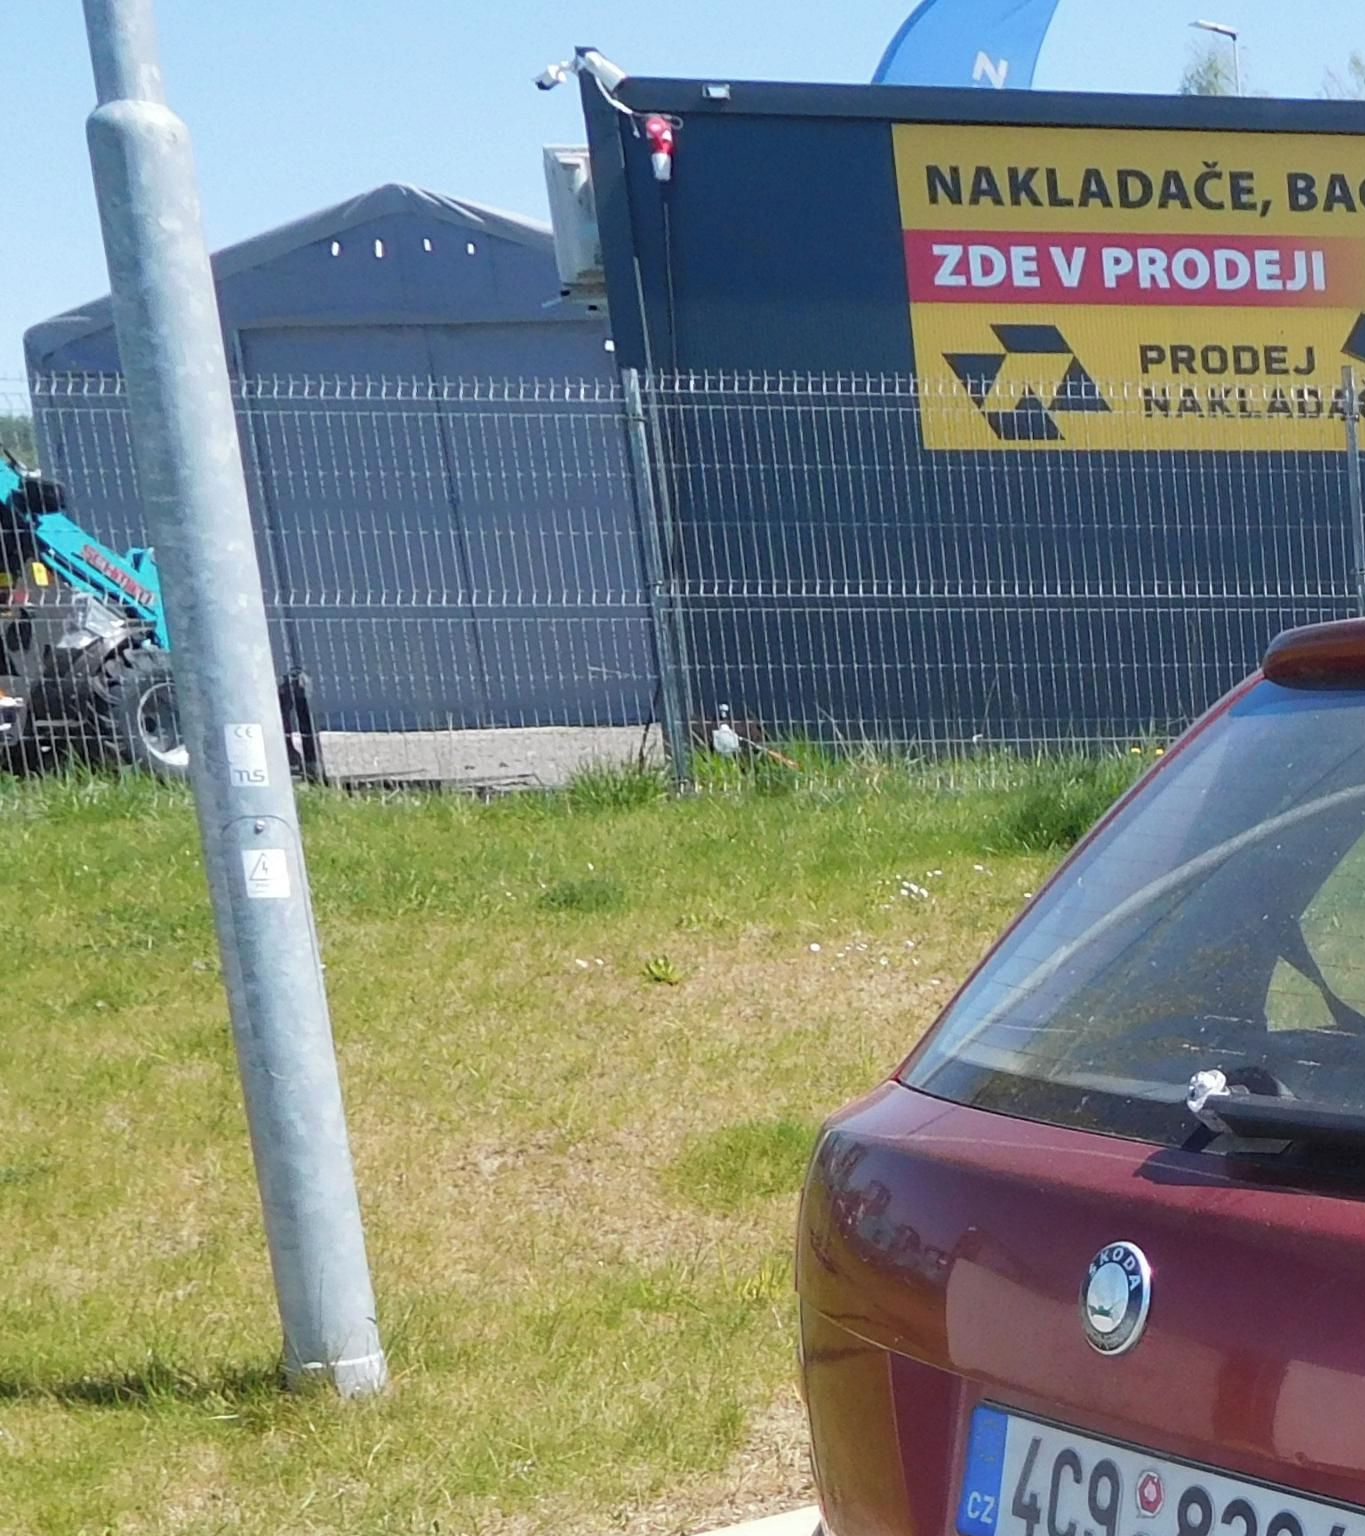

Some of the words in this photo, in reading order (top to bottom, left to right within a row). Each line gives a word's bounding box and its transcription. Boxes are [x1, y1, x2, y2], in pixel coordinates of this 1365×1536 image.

[925, 162, 1271, 217] NAKLADAČE,
[931, 244, 1041, 288] ZDE
[1048, 247, 1087, 286] V
[1101, 247, 1327, 292] PRODEJI
[1139, 343, 1316, 376] PRODEJ
[967, 1493, 995, 1525] CZ
